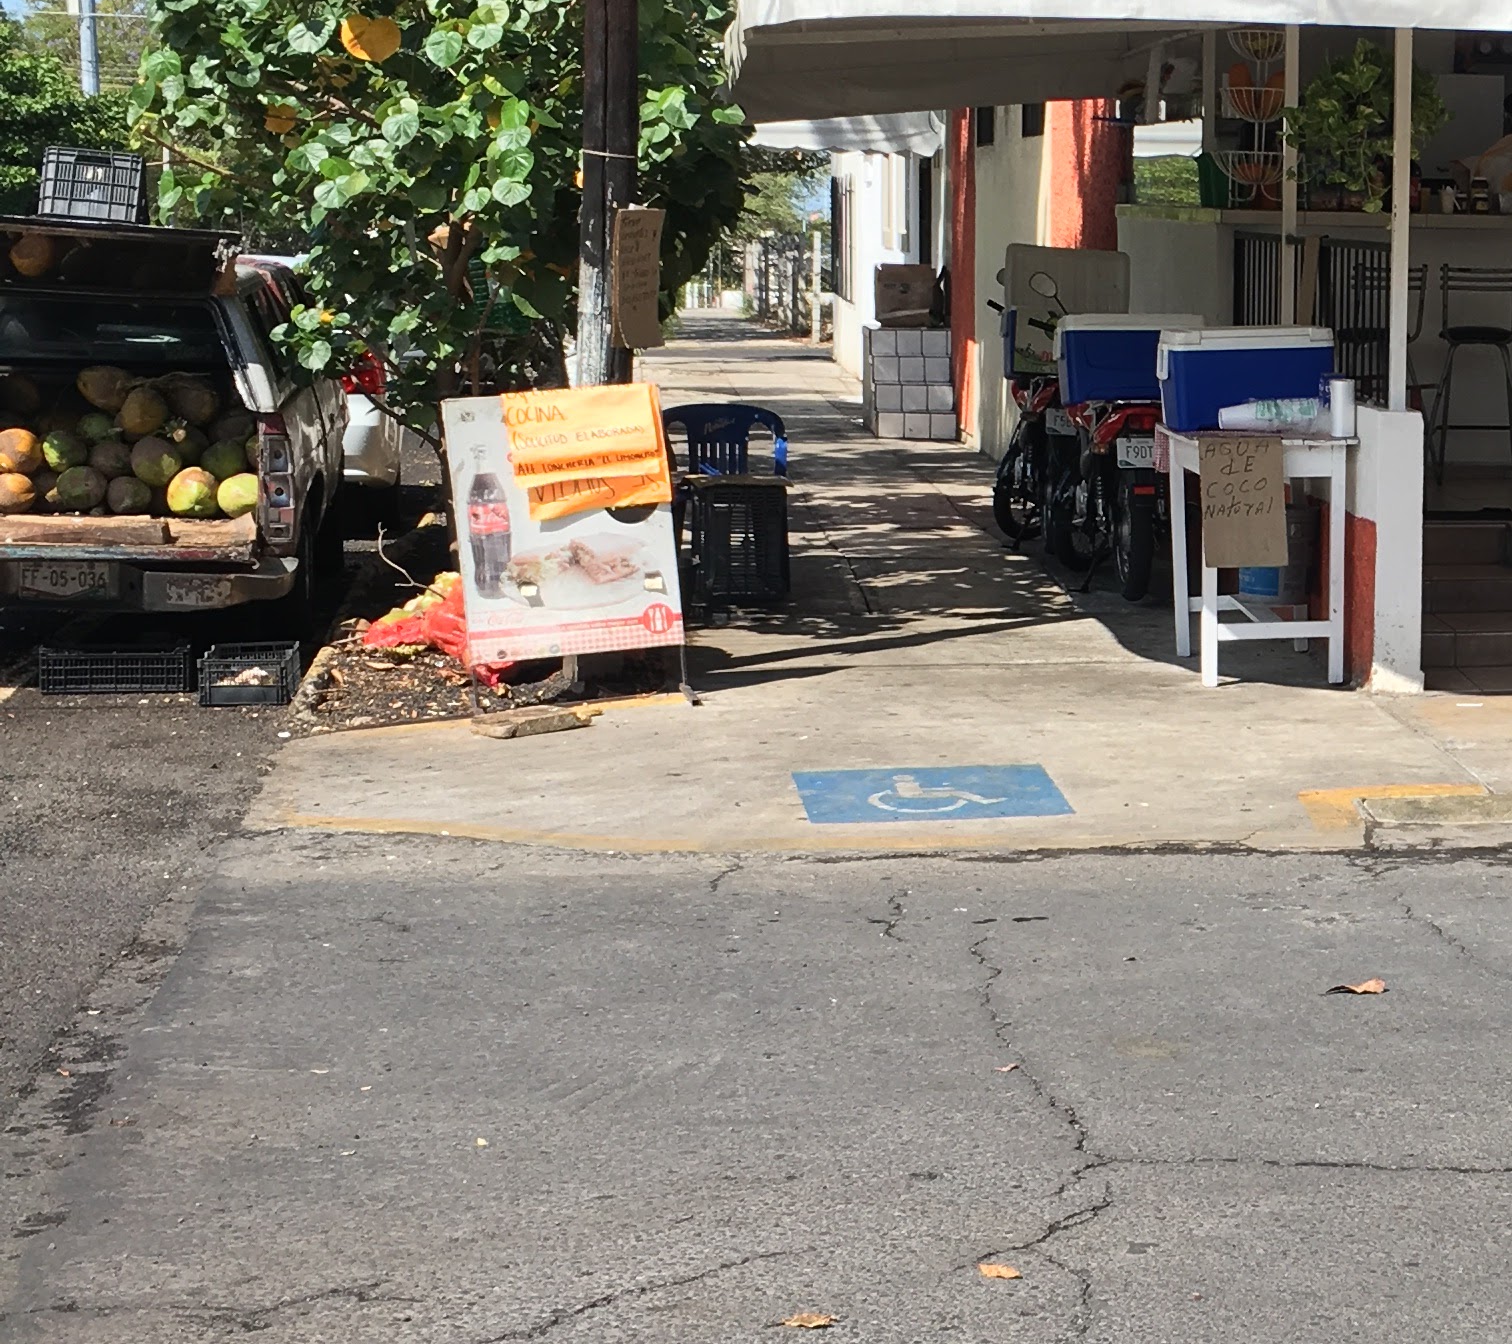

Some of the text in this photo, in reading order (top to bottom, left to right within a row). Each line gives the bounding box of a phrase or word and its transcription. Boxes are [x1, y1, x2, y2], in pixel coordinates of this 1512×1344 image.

[506, 405, 564, 427] COCINA
[1205, 440, 1270, 458] AGUA
[1206, 477, 1268, 499] COCO
[21, 567, 108, 588] FF-05-036
